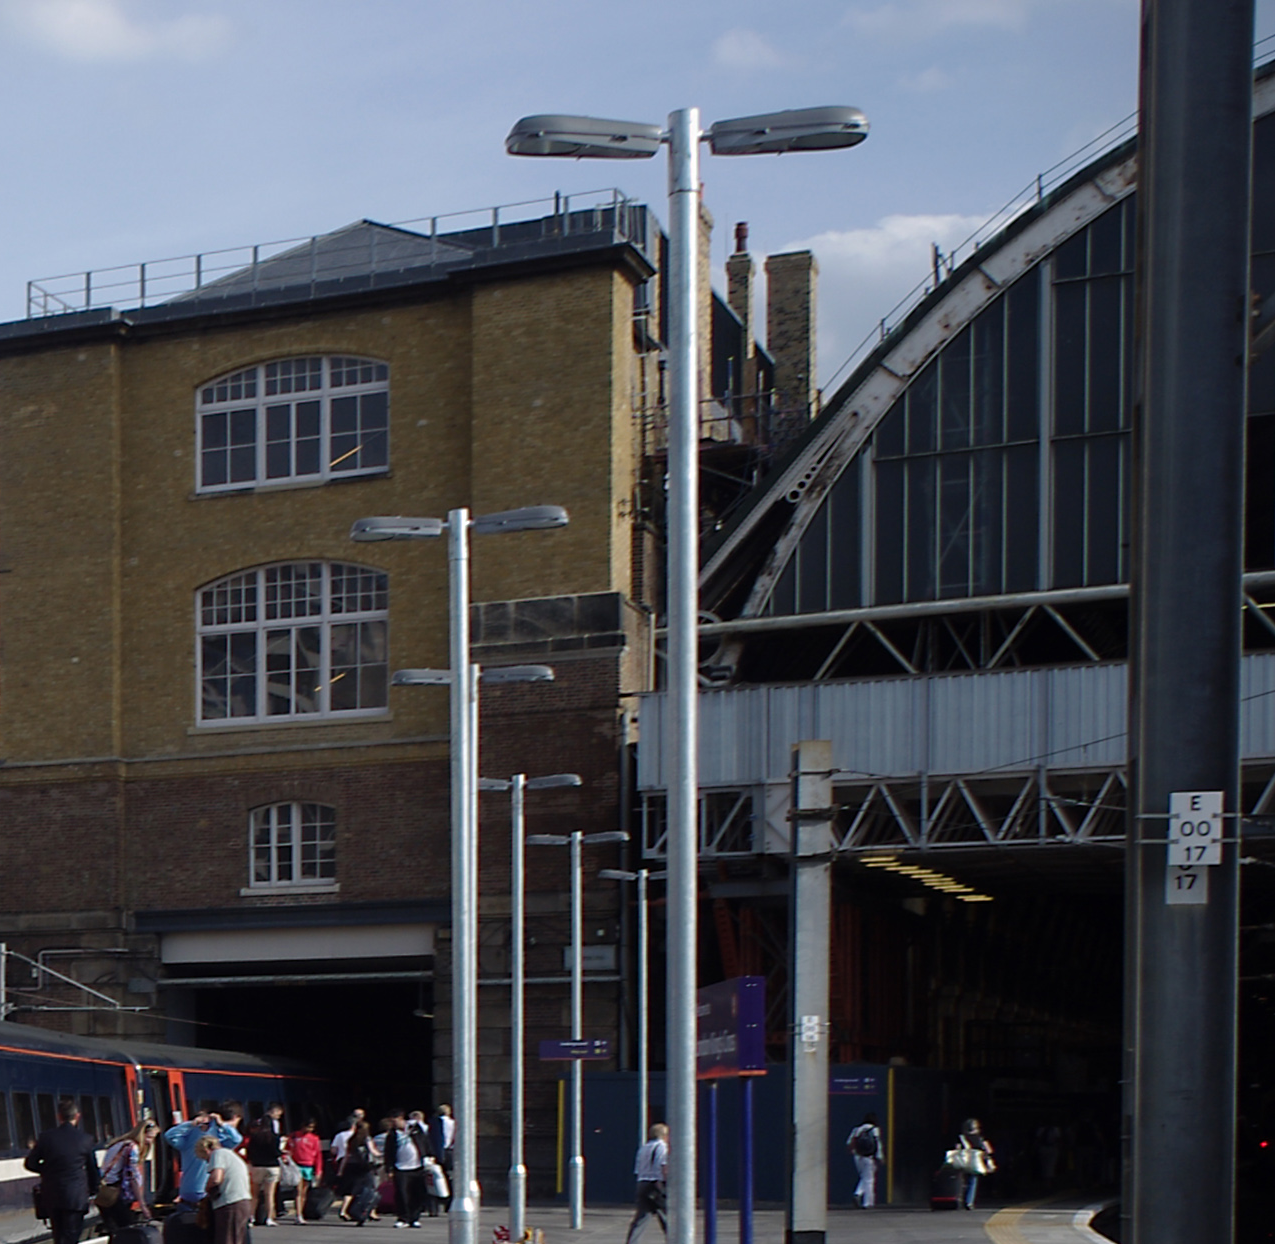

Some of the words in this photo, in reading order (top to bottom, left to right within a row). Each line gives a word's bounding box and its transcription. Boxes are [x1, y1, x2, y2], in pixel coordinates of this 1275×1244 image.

[1190, 795, 1202, 811] E
[1180, 821, 1211, 837] 00
[1184, 846, 1207, 862] 17
[1174, 874, 1197, 890] 17
